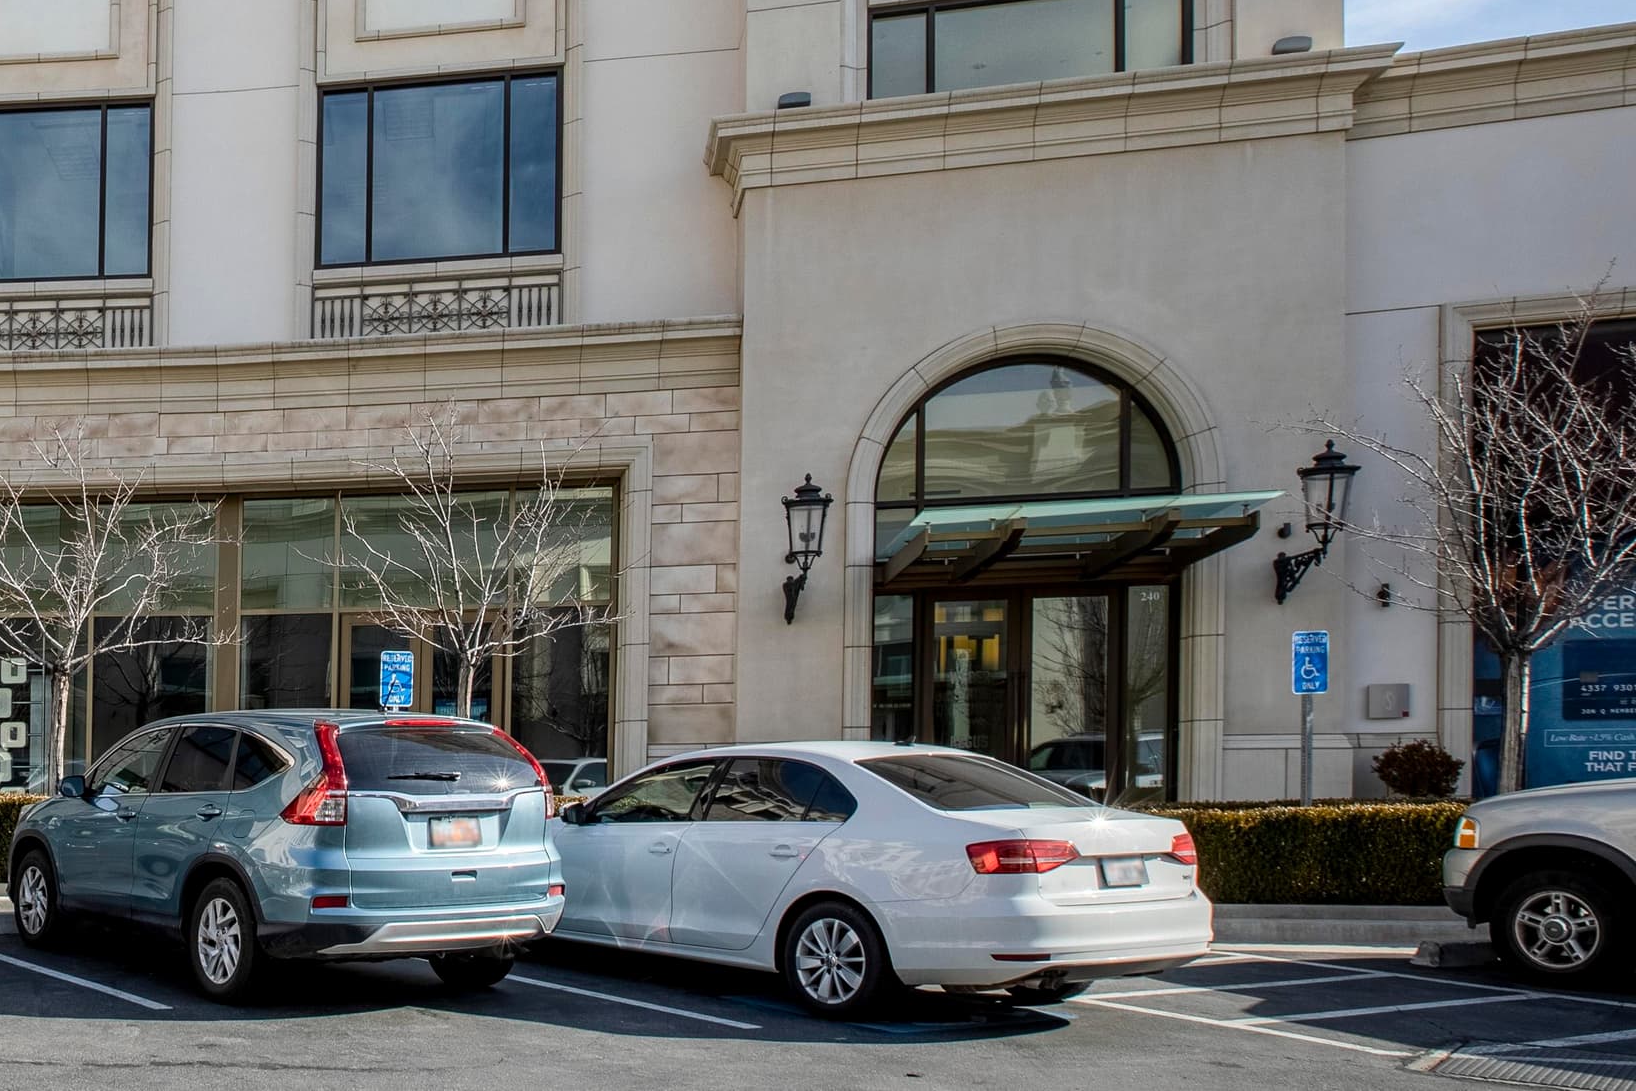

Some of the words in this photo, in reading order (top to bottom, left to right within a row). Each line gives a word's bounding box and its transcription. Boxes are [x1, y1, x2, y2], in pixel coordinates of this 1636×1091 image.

[1140, 591, 1160, 601] 240
[1294, 635, 1327, 644] RESERVED
[1295, 646, 1325, 654] PARKING
[383, 654, 412, 662] RESERVED
[1301, 681, 1320, 690] ONLY
[388, 695, 405, 703] ONLY
[1589, 750, 1626, 761] FIND
[1584, 762, 1624, 772] THAT
